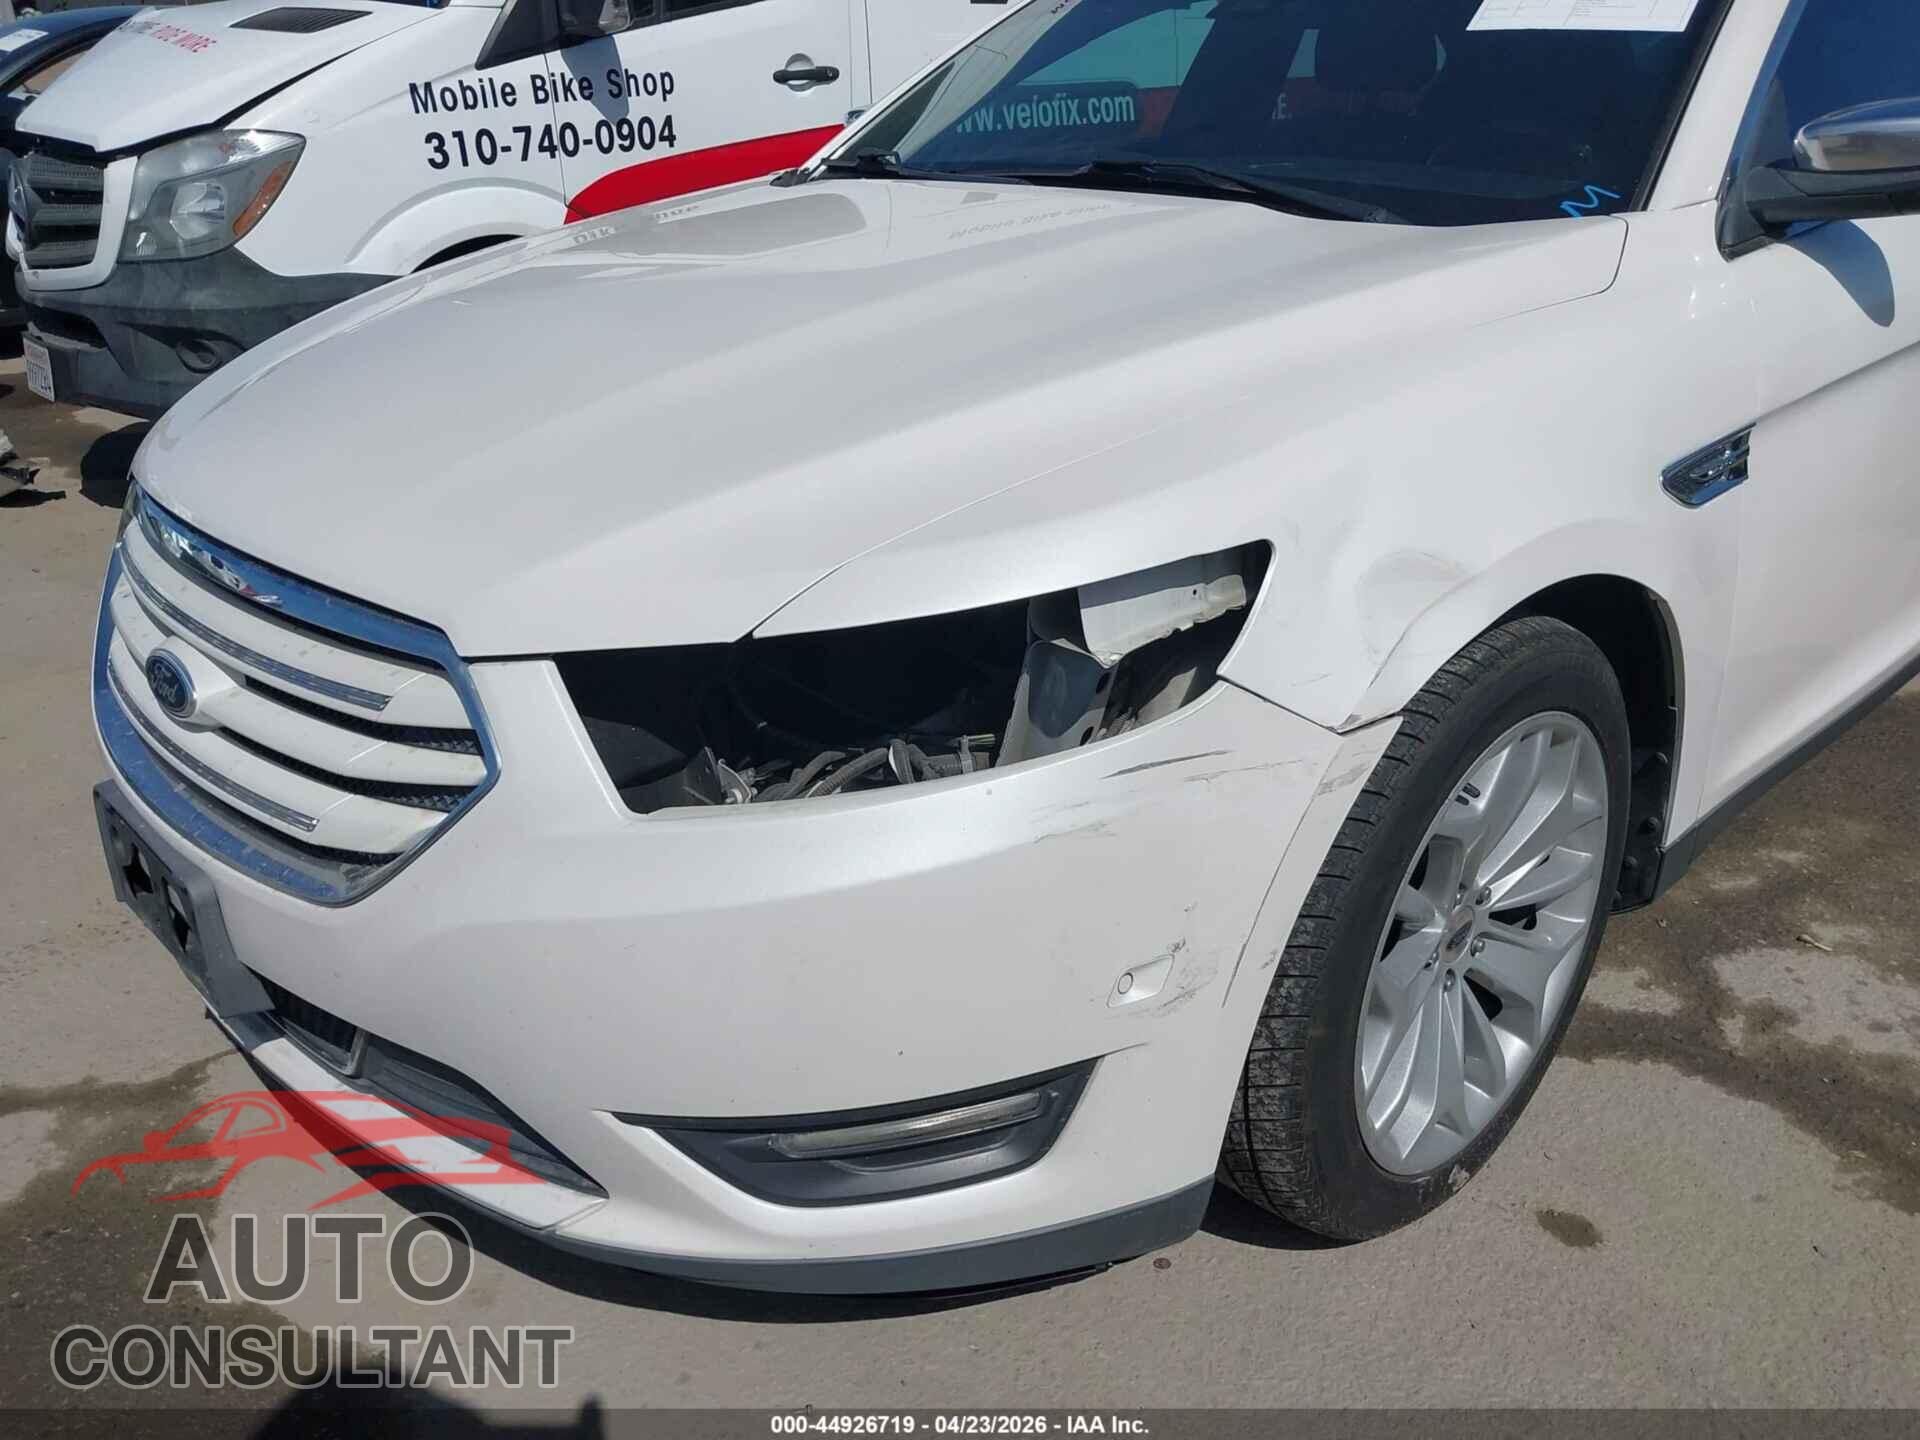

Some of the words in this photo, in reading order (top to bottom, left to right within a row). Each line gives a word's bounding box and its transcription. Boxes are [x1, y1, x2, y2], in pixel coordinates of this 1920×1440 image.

[408, 77, 518, 114] Mobile
[530, 72, 594, 104] Bike
[606, 68, 675, 102] Shop
[424, 114, 677, 170] 310-740-0904
[151, 663, 178, 704] Ford
